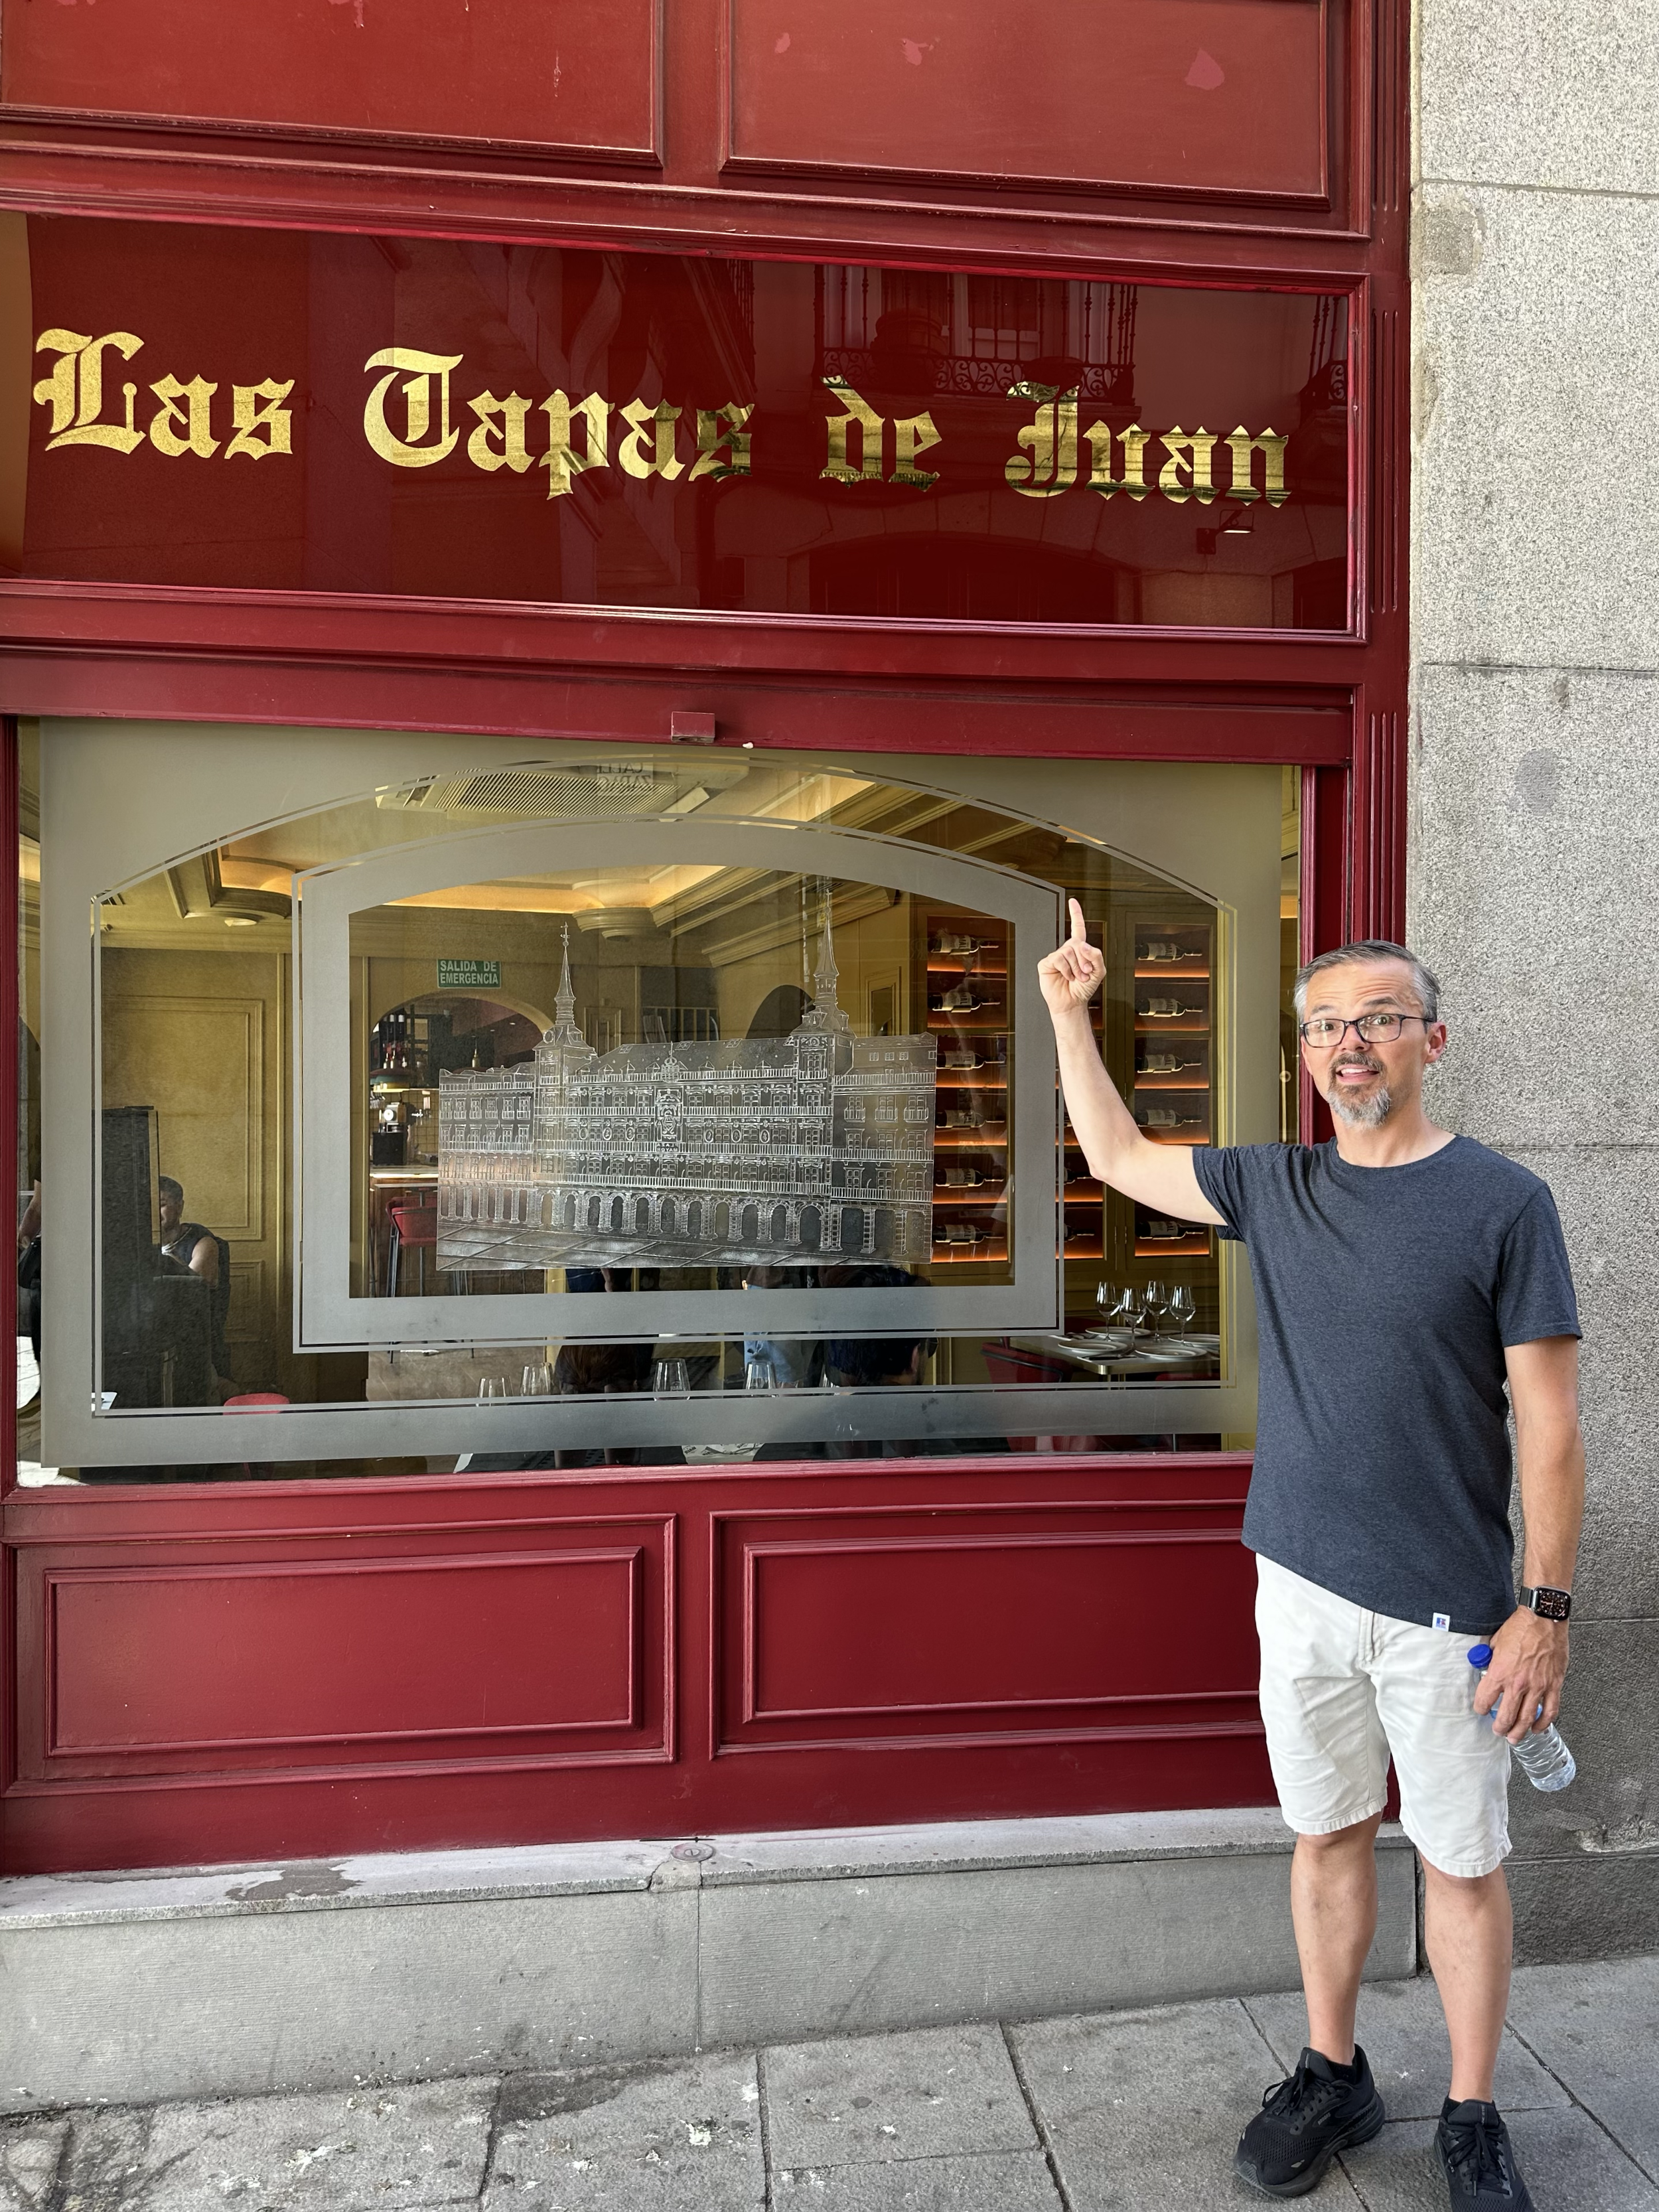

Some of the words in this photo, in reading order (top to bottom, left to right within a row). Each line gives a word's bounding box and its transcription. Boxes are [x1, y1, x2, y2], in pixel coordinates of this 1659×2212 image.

[33, 328, 295, 461] Las
[364, 347, 755, 501] Tapas
[820, 374, 942, 492] de
[1004, 380, 1292, 508] Juan
[440, 960, 477, 972] SALIDA
[483, 961, 496, 972] DE
[440, 973, 498, 984] EMERGENCIA
